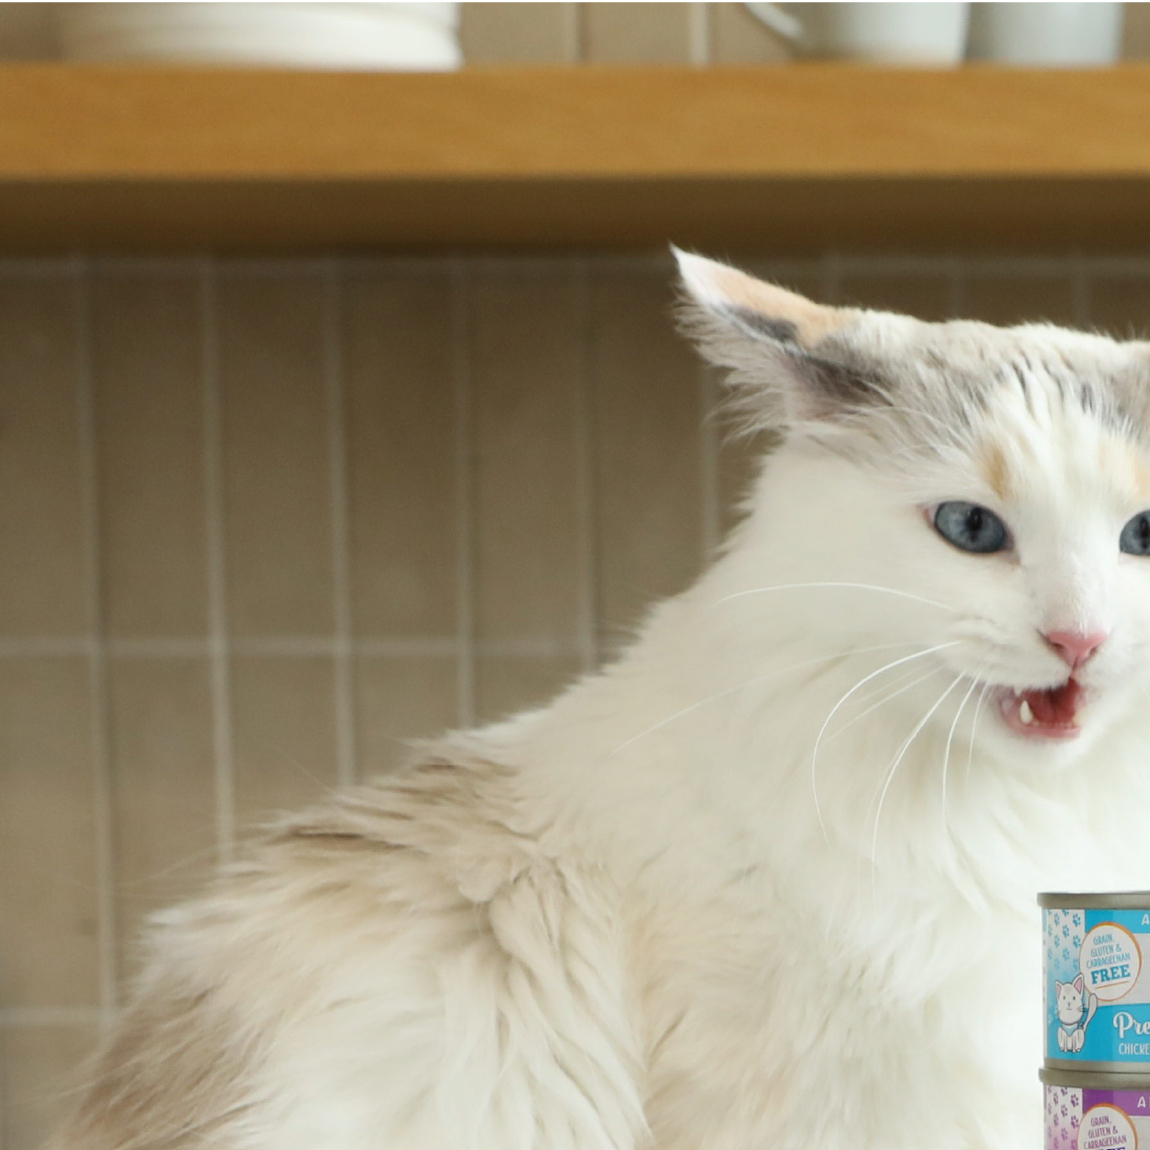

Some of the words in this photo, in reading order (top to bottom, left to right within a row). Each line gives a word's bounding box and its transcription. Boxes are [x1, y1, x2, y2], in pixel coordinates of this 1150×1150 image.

[1141, 914, 1150, 925] A
[1091, 964, 1131, 985] FREE
[1137, 1097, 1147, 1109] A
